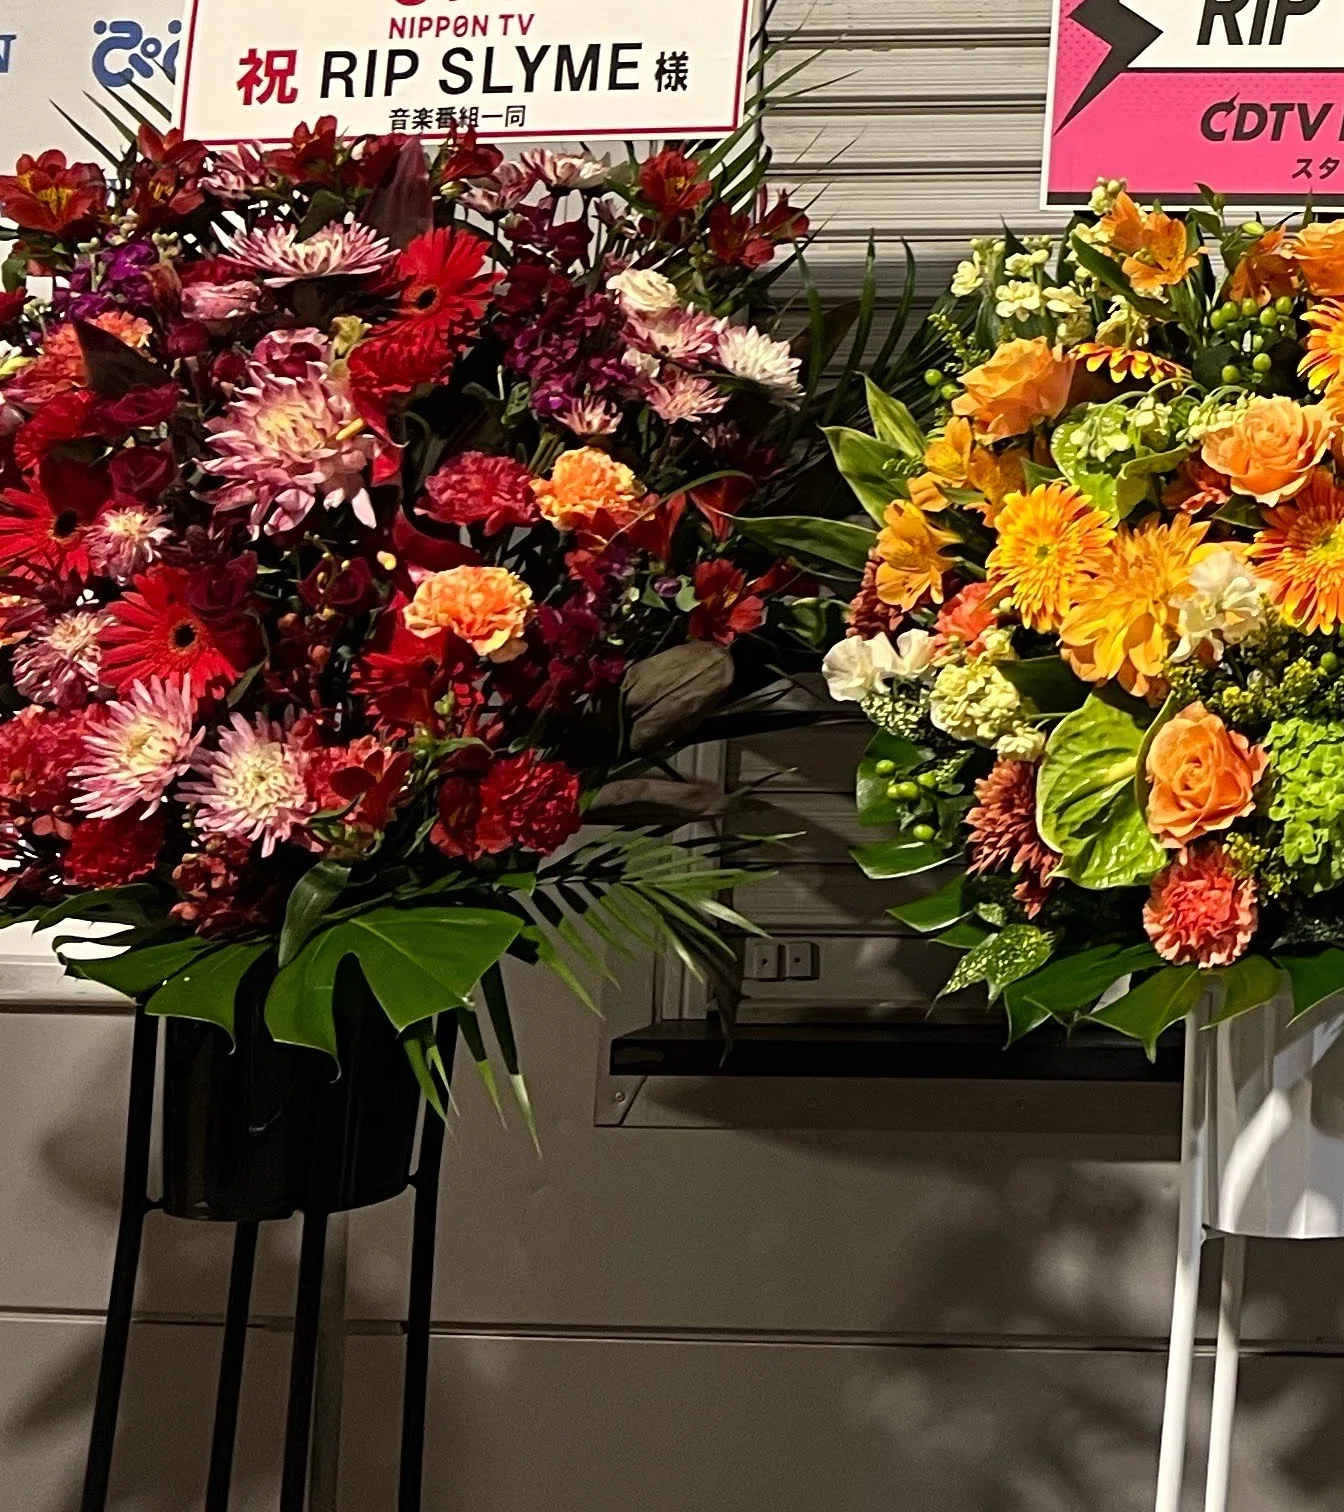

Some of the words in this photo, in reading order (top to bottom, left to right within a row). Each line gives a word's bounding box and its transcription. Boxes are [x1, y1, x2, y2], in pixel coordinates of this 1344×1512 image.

[498, 12, 536, 35] TV
[236, 48, 298, 106] 祝
[320, 47, 420, 99] RIP
[438, 41, 643, 96] SLYME
[654, 51, 689, 93] 様
[389, 104, 527, 131] 音楽番組一同
[1200, 92, 1332, 143] CDTV
